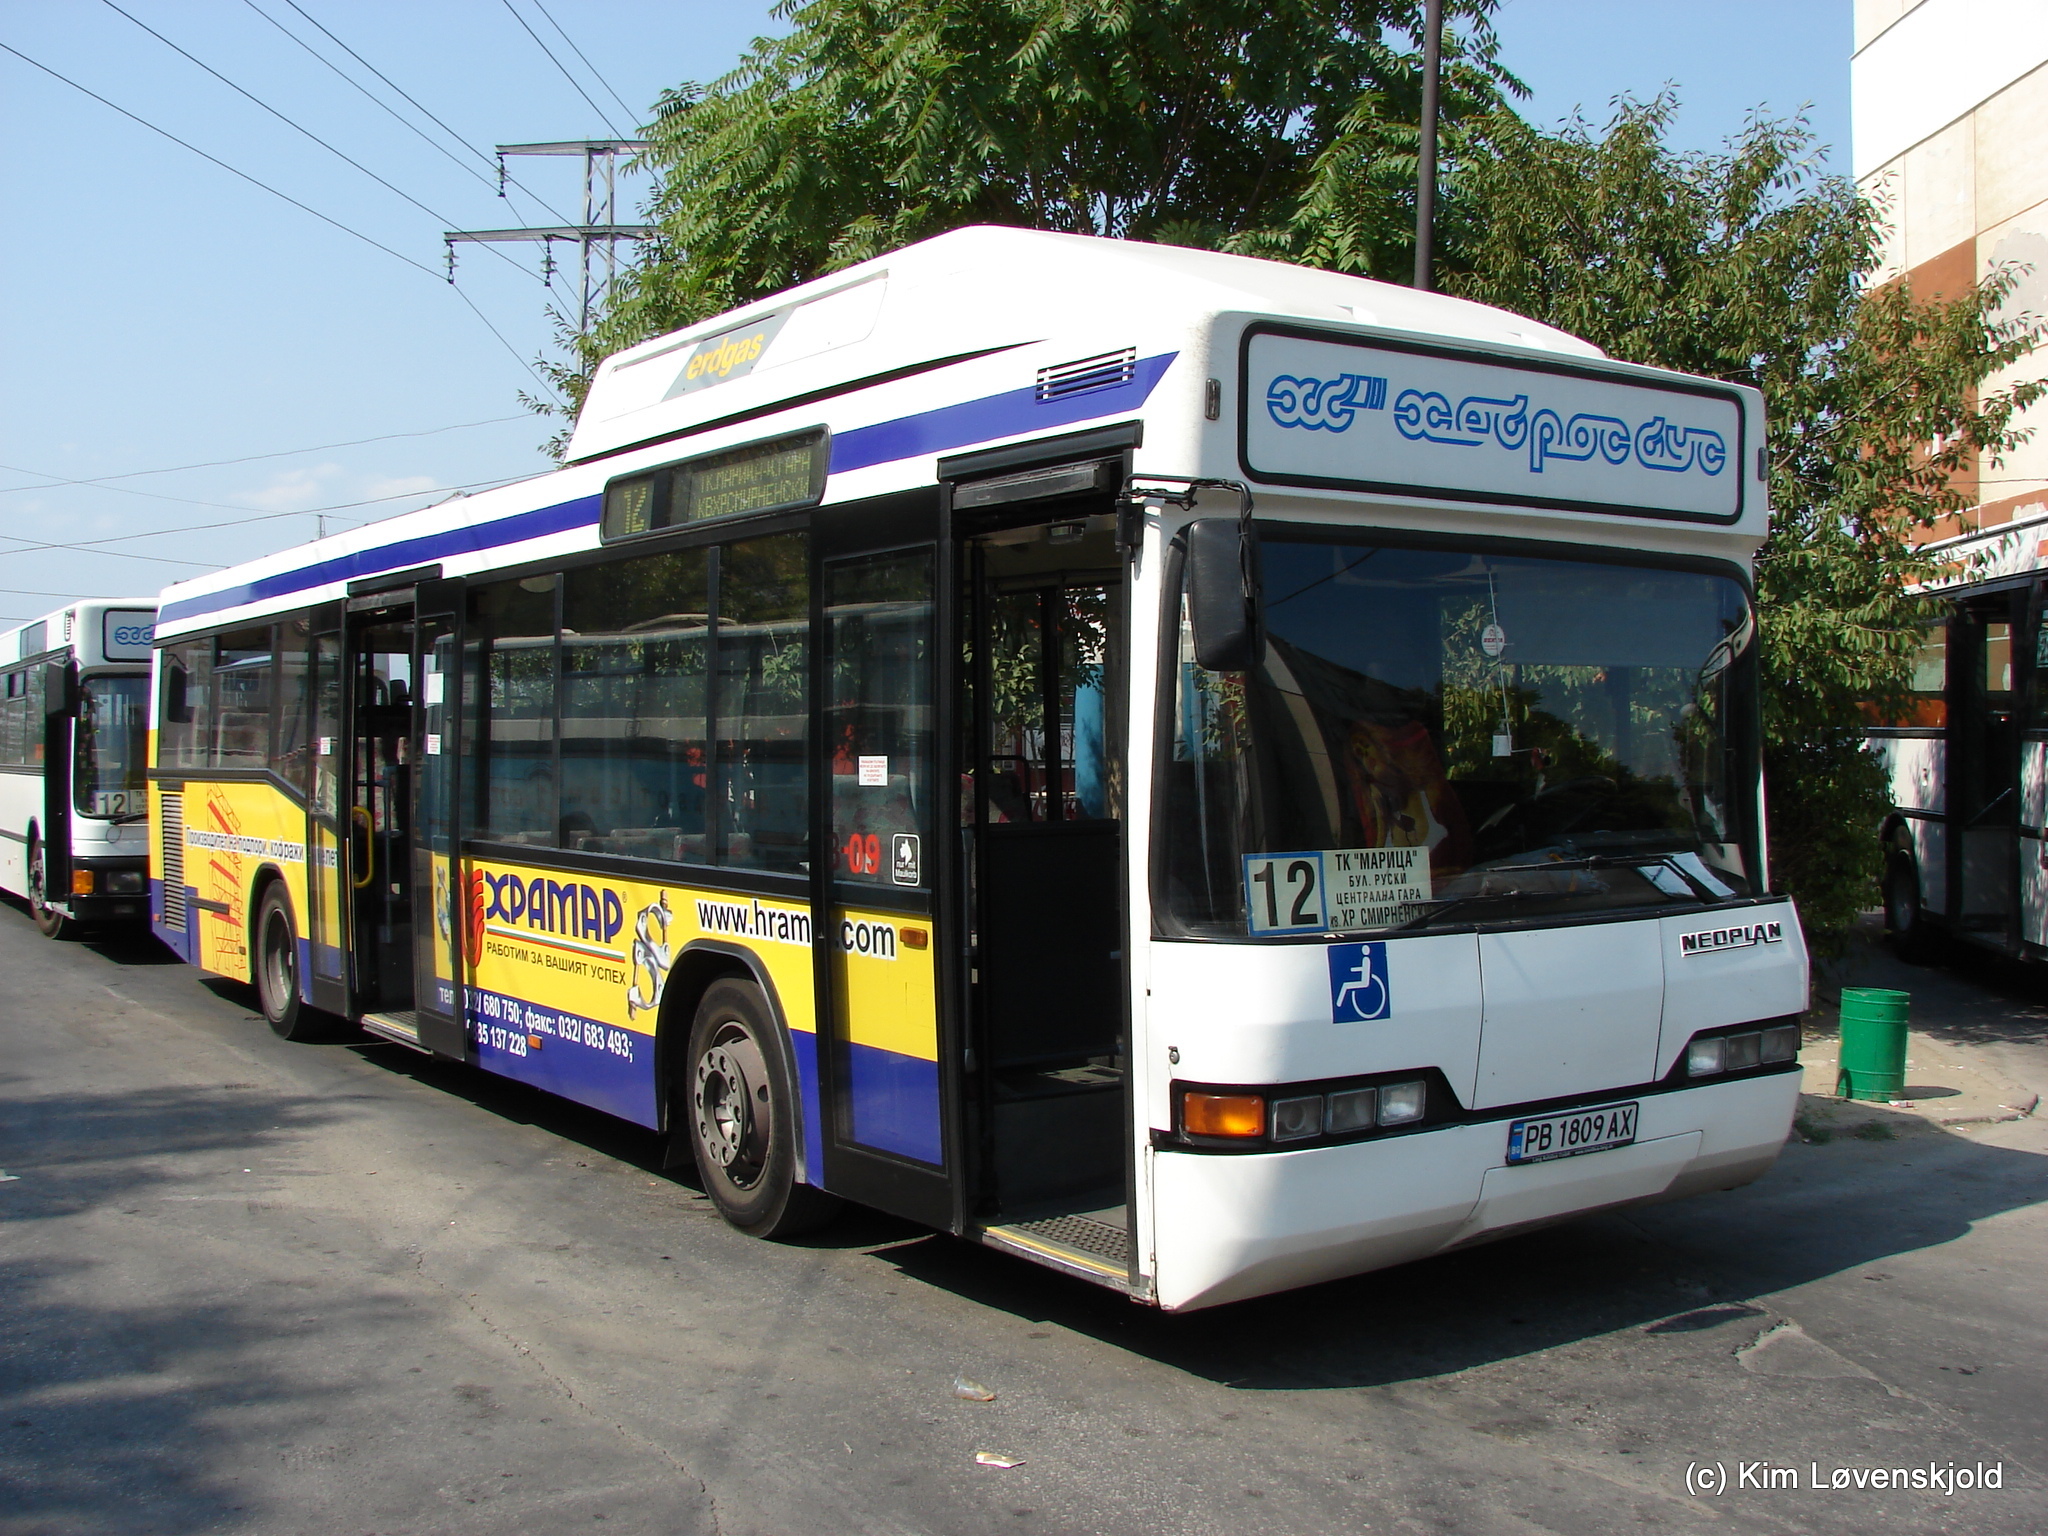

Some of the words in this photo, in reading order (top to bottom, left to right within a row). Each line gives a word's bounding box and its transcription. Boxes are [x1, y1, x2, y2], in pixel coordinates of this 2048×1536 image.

[686, 333, 764, 380] erdgas
[623, 486, 647, 534] 12
[99, 793, 127, 814] 12
[1335, 853, 1350, 872] ТК
[1253, 860, 1318, 927] 12
[1348, 875, 1372, 887] БУЛ.
[1374, 873, 1407, 886] РУСКИ
[485, 870, 624, 944] ХРАМАР
[1336, 889, 1395, 906] ЦЕНТРАЛНА
[1397, 888, 1421, 901] ГАРА
[1341, 908, 1355, 927] ХР
[1681, 922, 1782, 955] NEOPLAN
[486, 941, 529, 962] РАБОТИМ
[530, 951, 544, 966] ЗА
[545, 954, 588, 977] ВАШИЯТ
[590, 965, 627, 986] УСПЕХ
[483, 993, 501, 1018] 680
[501, 998, 523, 1029] 750;
[524, 1006, 557, 1036] факс:
[558, 1014, 582, 1043] 032/
[584, 1021, 605, 1051] 683
[607, 1029, 634, 1063] 493;
[490, 1025, 507, 1050] 137
[509, 1031, 528, 1058] 228
[1560, 1114, 1604, 1148] 1809
